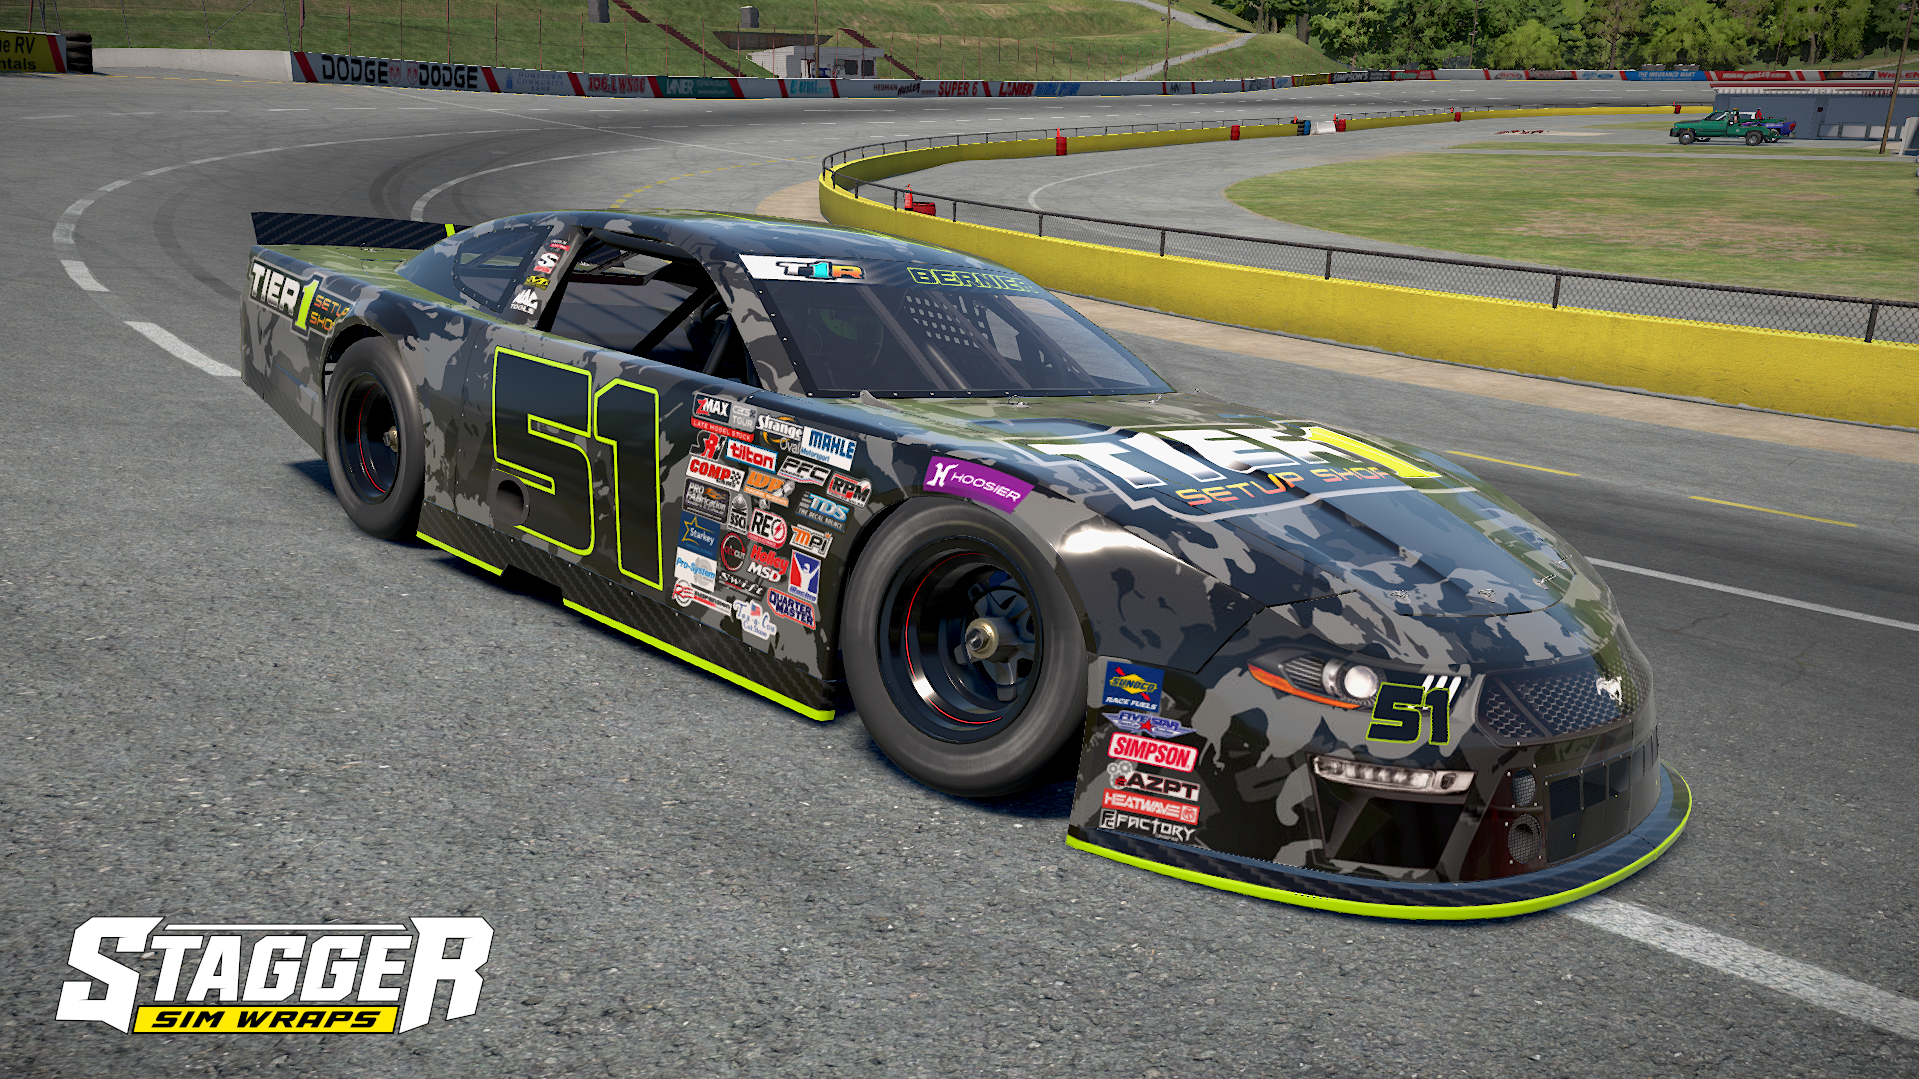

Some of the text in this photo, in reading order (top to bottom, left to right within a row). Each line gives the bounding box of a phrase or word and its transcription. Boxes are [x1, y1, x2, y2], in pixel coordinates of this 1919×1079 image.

[15, 36, 36, 54] RV
[321, 54, 478, 89] DODGE DODGE
[516, 77, 564, 87] COMMUNITY
[518, 71, 563, 80] HOMETOWN
[530, 84, 550, 92] BANK
[938, 81, 979, 97] SUPER 6
[998, 81, 1035, 97] LANIER
[693, 420, 752, 442] LATE MODEL STOCK
[732, 415, 754, 429] TOUR
[755, 413, 803, 439] Strange
[729, 442, 775, 469] tilton
[779, 437, 800, 455] Oval
[808, 429, 856, 460] MAHLE
[492, 345, 664, 592] 51
[689, 458, 731, 481] COMP
[746, 470, 785, 492] WP
[782, 456, 830, 482] PFC
[688, 481, 705, 493] PRO
[832, 476, 871, 502] RPM
[950, 471, 1021, 503] HOOSIER
[1175, 466, 1391, 507] SETUP SHOP
[797, 507, 808, 515] THE
[808, 511, 824, 522] DECAL
[808, 492, 850, 522] TDS
[689, 527, 715, 547] Starkey
[746, 561, 783, 583] MSD
[750, 544, 790, 576] Holley
[769, 589, 812, 615] QUARTER
[775, 602, 813, 627] MASTER
[1110, 676, 1158, 692] SUNOCO
[1105, 696, 1158, 711] RACE FUELS
[1365, 682, 1450, 745] 51
[1113, 736, 1192, 768] SIMPSON
[1126, 771, 1199, 800] AZPT
[1104, 792, 1181, 818] HEATWAVE
[1116, 814, 1197, 842] FACTORY
